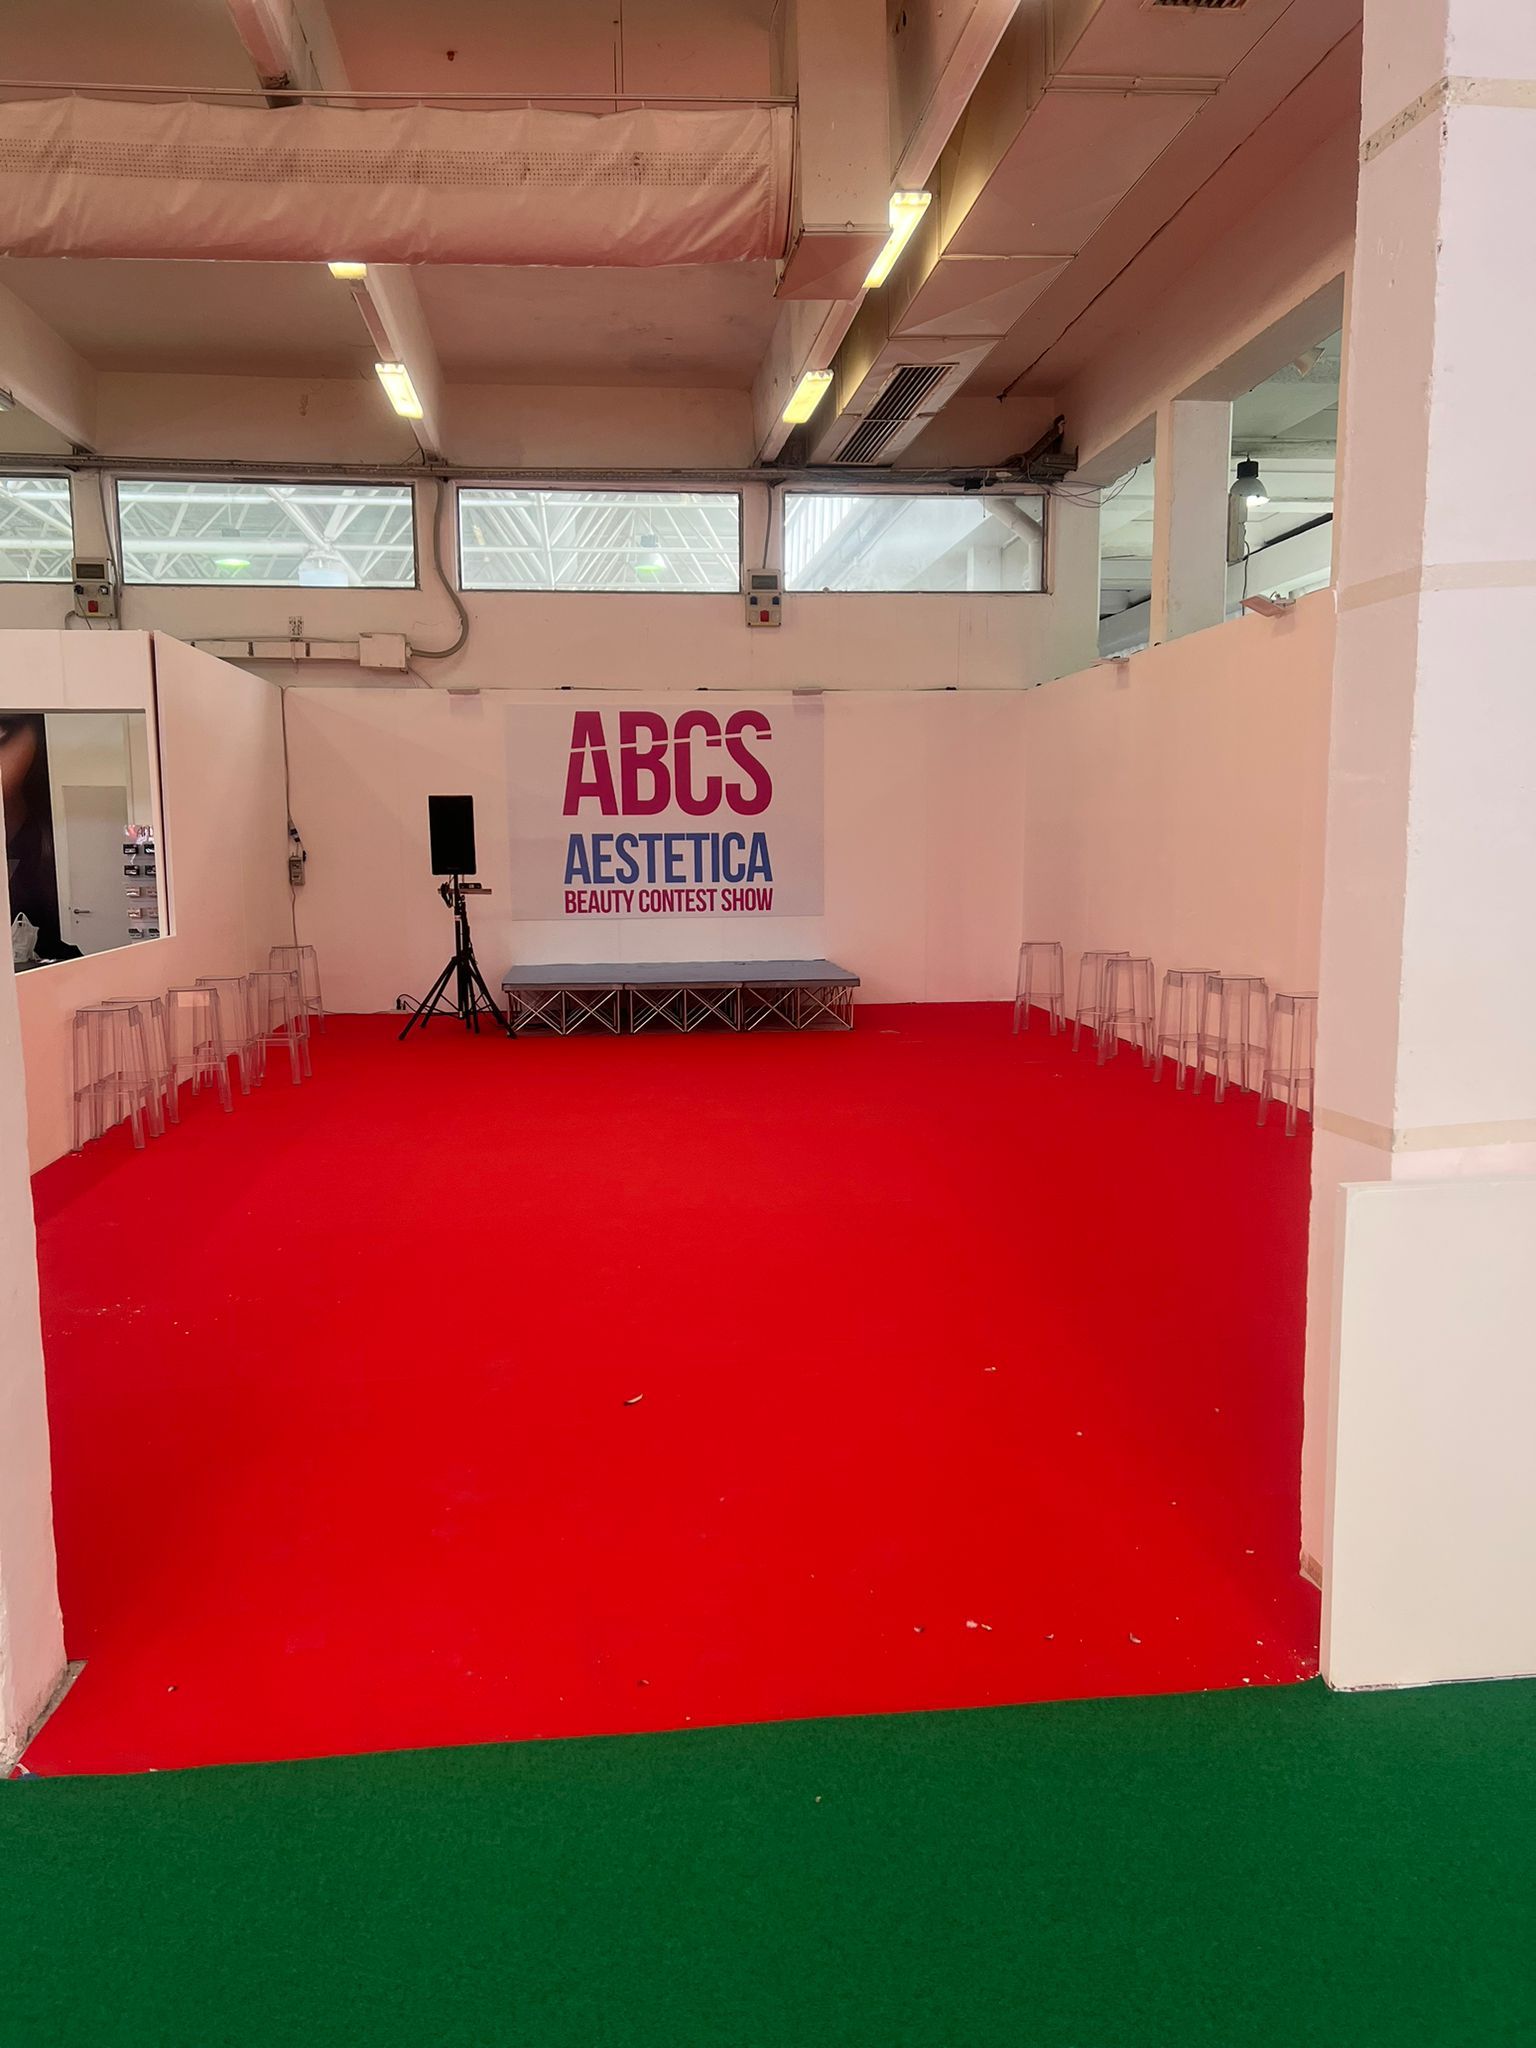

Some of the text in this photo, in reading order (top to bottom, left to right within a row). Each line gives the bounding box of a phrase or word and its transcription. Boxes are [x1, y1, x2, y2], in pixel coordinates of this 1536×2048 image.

[563, 710, 773, 816] ABCS
[564, 832, 773, 884] AESTETICA
[565, 888, 773, 914] BEAUTY CONTEST SHOW
